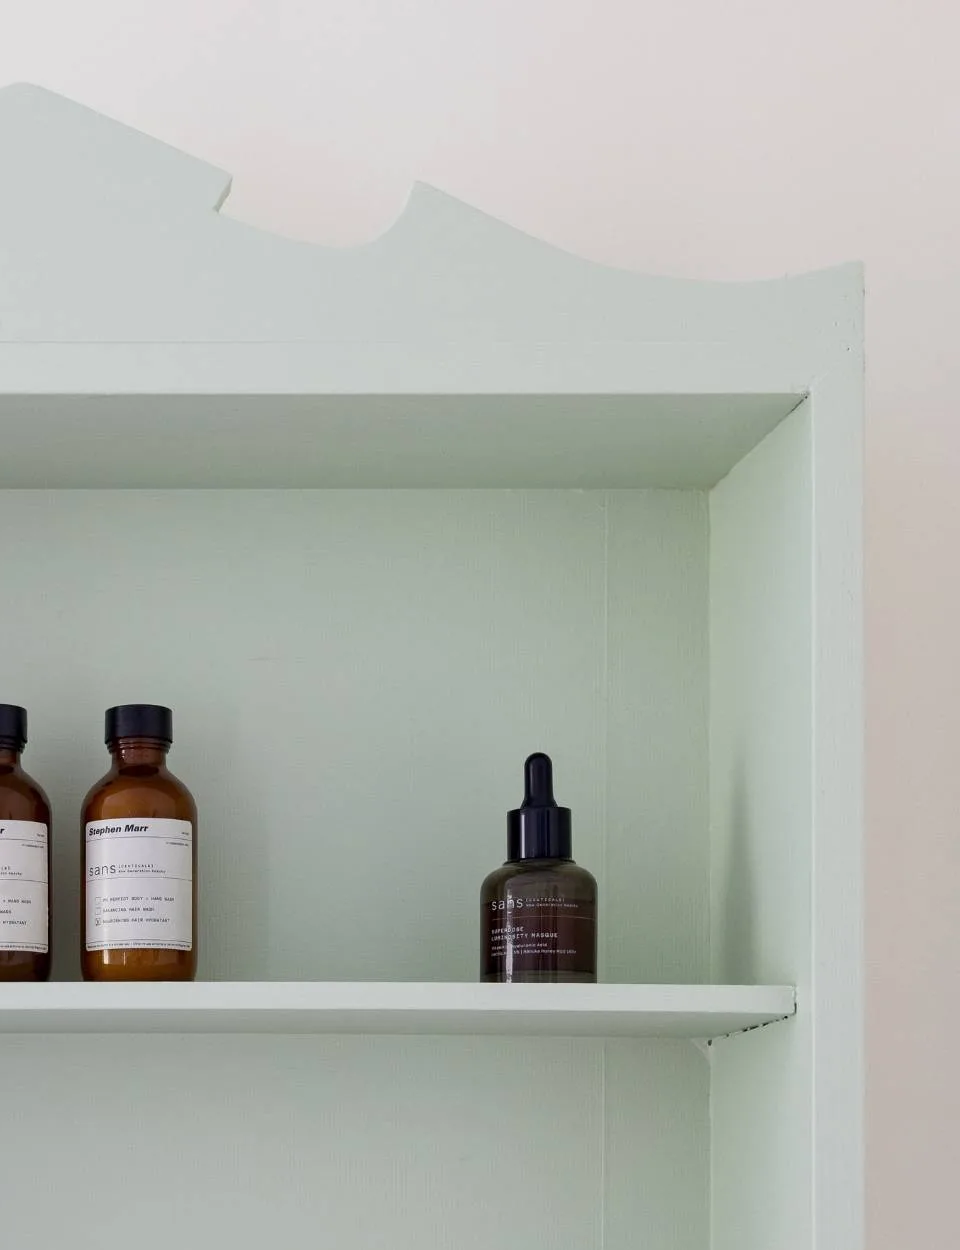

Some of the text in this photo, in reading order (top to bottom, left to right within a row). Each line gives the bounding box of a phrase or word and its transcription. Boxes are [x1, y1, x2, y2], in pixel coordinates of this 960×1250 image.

[89, 824, 149, 837] Stephen Marr
[89, 864, 117, 877] sans
[491, 898, 524, 911] sans
